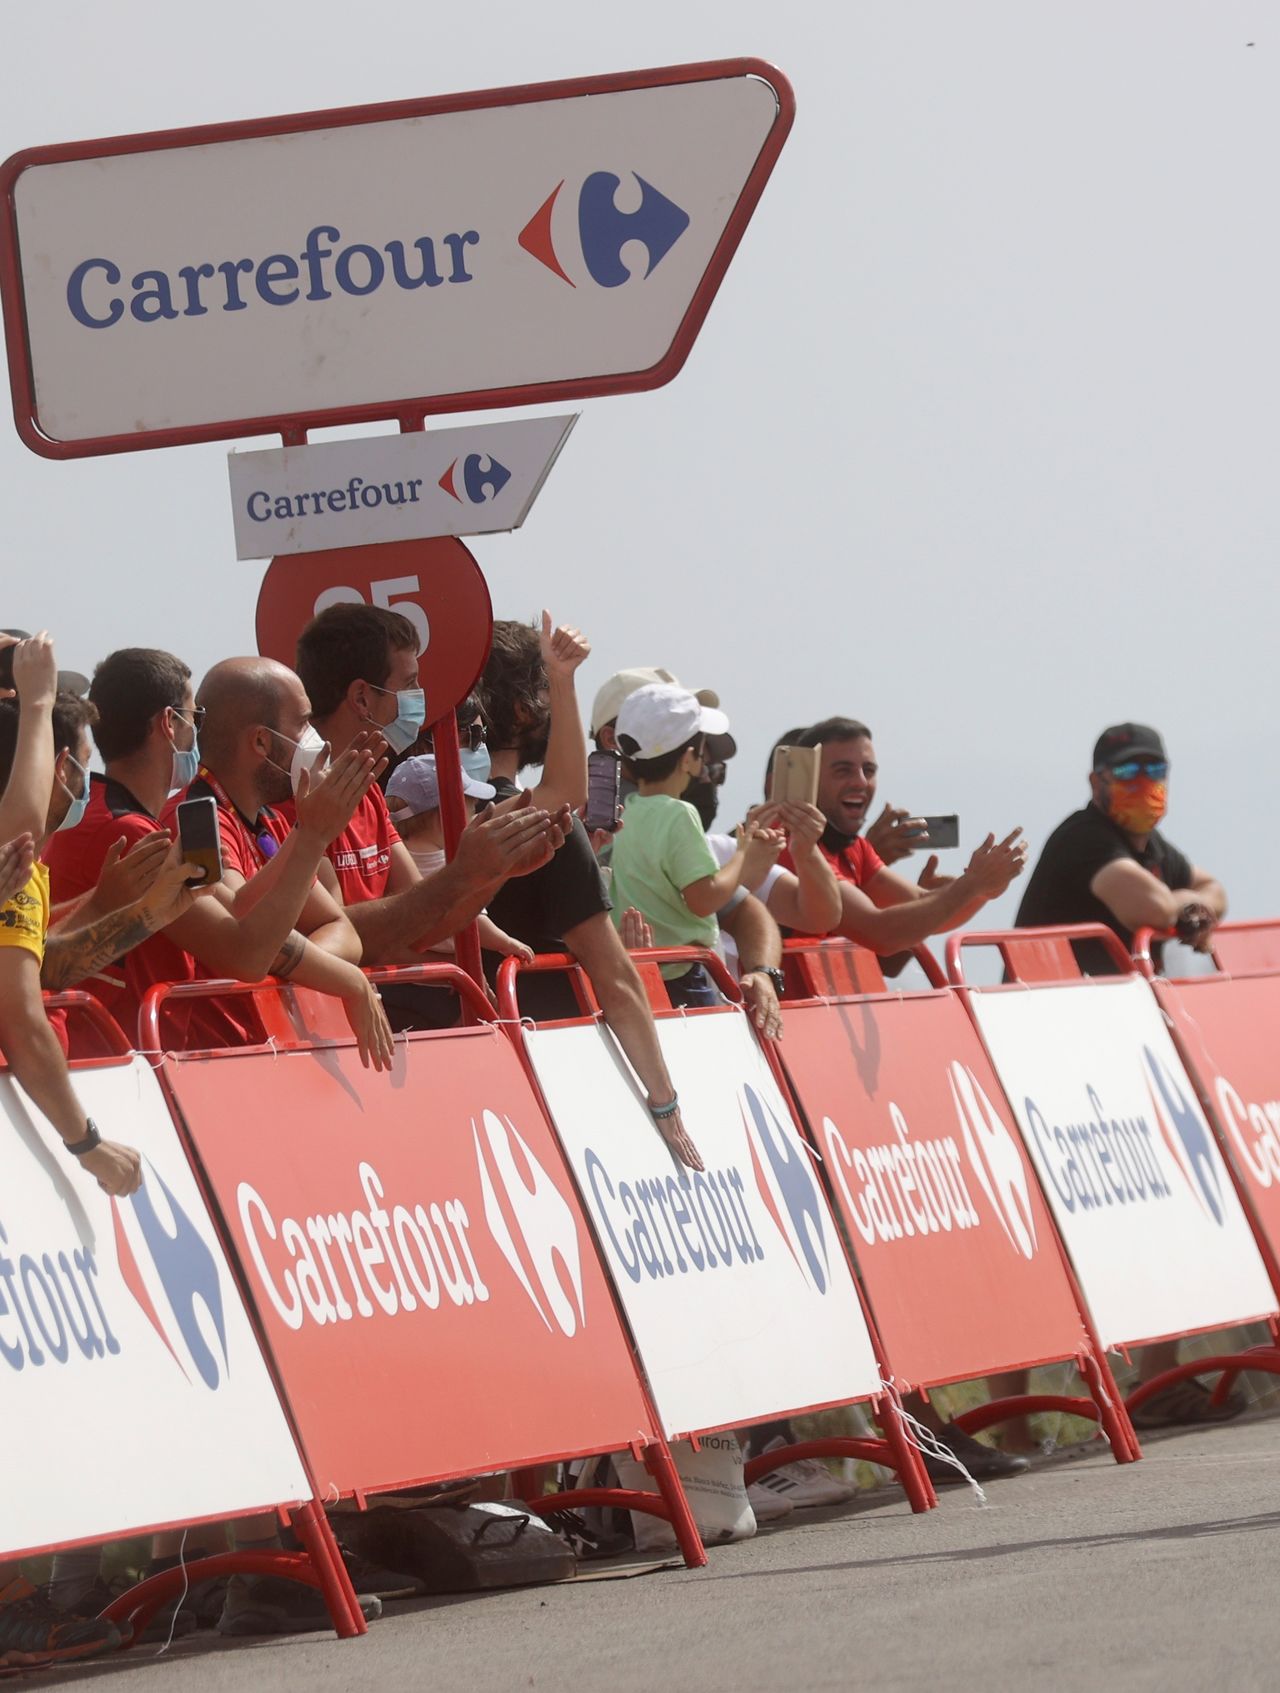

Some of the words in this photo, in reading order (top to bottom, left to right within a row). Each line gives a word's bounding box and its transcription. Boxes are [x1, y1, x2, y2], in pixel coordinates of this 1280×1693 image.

[66, 225, 480, 329] Carrefour
[246, 478, 423, 524] Carrefour
[823, 1101, 980, 1246] Carrefour
[1025, 1082, 1172, 1214] Carrefour
[237, 1161, 490, 1331] Carrefour
[585, 1147, 765, 1284] Carrefour
